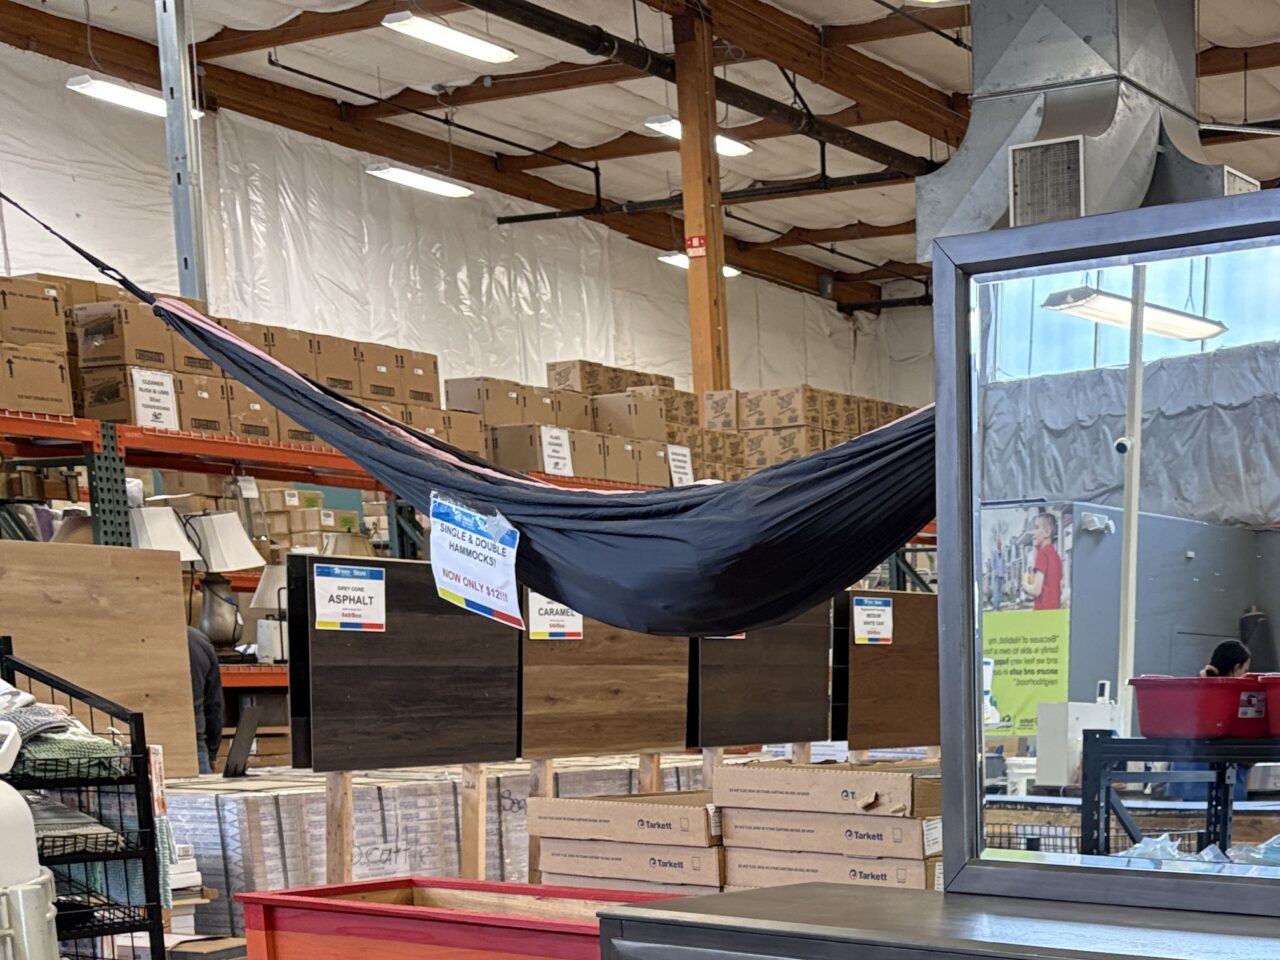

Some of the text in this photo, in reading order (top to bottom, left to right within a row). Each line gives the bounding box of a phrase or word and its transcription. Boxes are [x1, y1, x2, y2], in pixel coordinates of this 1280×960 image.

[439, 523, 508, 558] SINGLE & DOUBLE
[448, 540, 498, 568] HAMMOCKS!
[442, 567, 462, 584] NOW
[462, 575, 485, 592] ONLY
[327, 593, 374, 606] ASPHALT
[537, 607, 576, 617] CARAMEL
[645, 819, 673, 831] Tarkett
[854, 829, 884, 841] Tarkett
[657, 859, 684, 870] Tarkett
[857, 869, 888, 882] Tarkett
